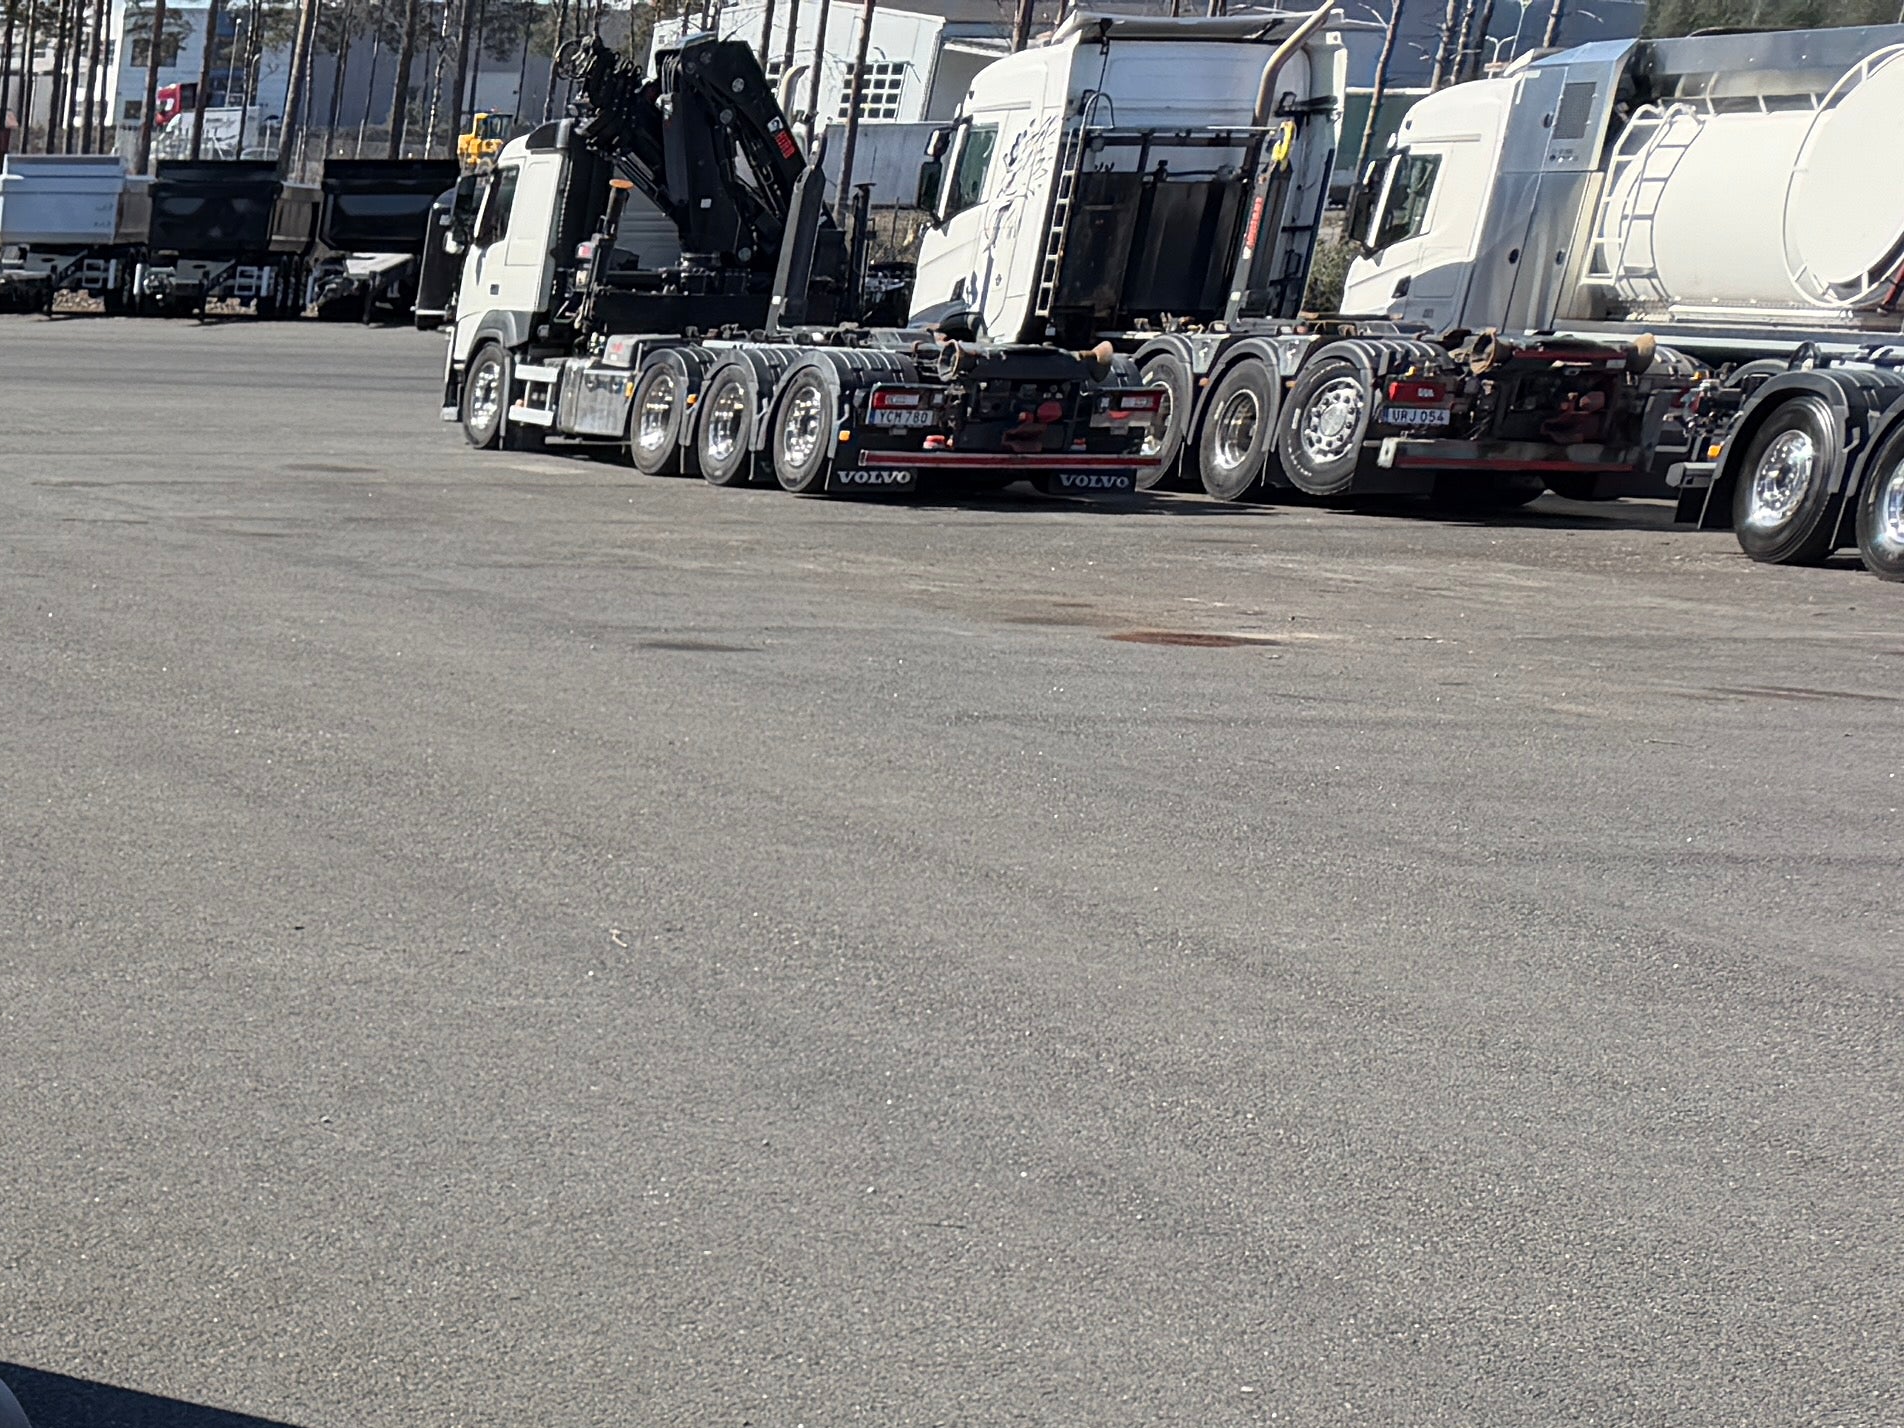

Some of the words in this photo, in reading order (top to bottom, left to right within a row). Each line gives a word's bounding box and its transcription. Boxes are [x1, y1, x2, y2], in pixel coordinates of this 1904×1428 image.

[906, 412, 929, 423] 780
[837, 471, 911, 484] VOLVO
[1059, 474, 1130, 488] VOLVO
